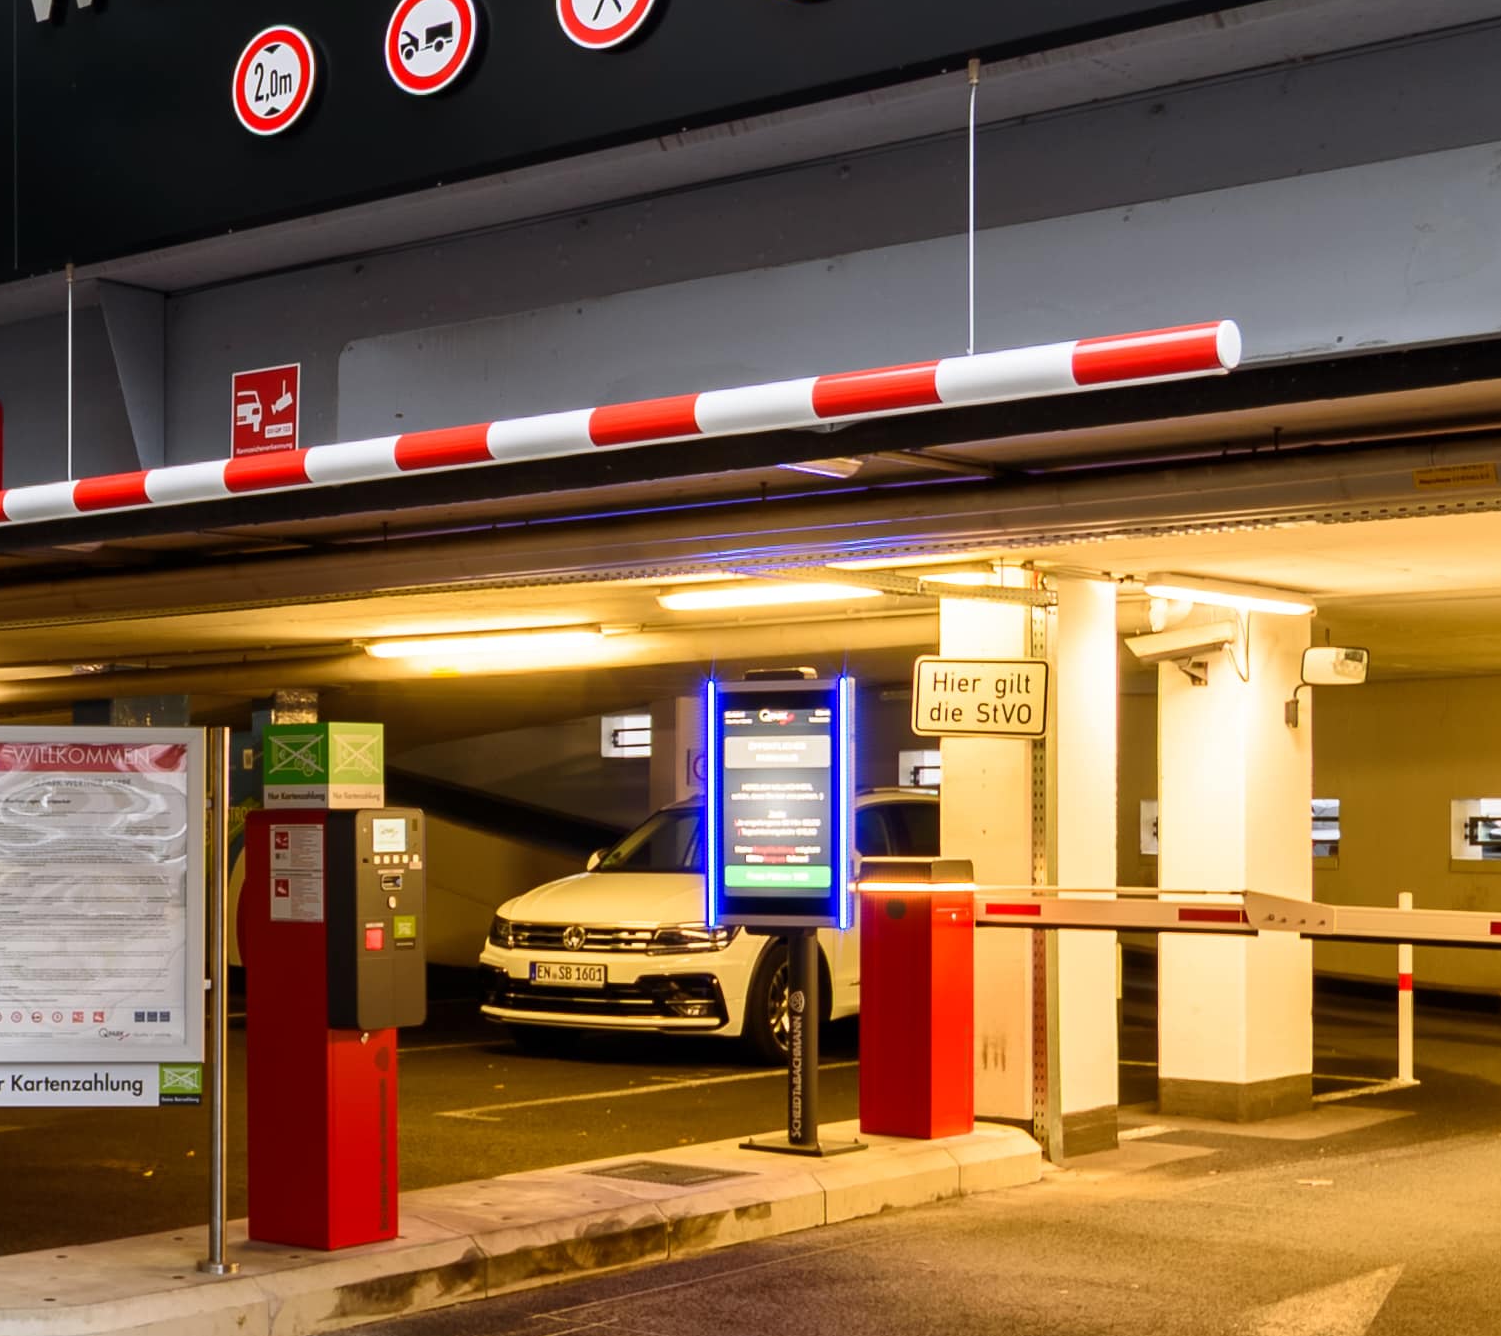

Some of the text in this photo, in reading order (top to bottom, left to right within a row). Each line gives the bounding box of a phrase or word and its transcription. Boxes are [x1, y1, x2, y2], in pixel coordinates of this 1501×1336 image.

[254, 62, 292, 103] 2,0m
[933, 672, 1031, 699] Hier gilt
[930, 702, 1032, 725] die StVO
[13, 747, 150, 764] WILLKOMMEN
[537, 967, 551, 979] EN
[575, 967, 603, 982] 1601
[11, 1073, 143, 1096] Kartenzahlung
